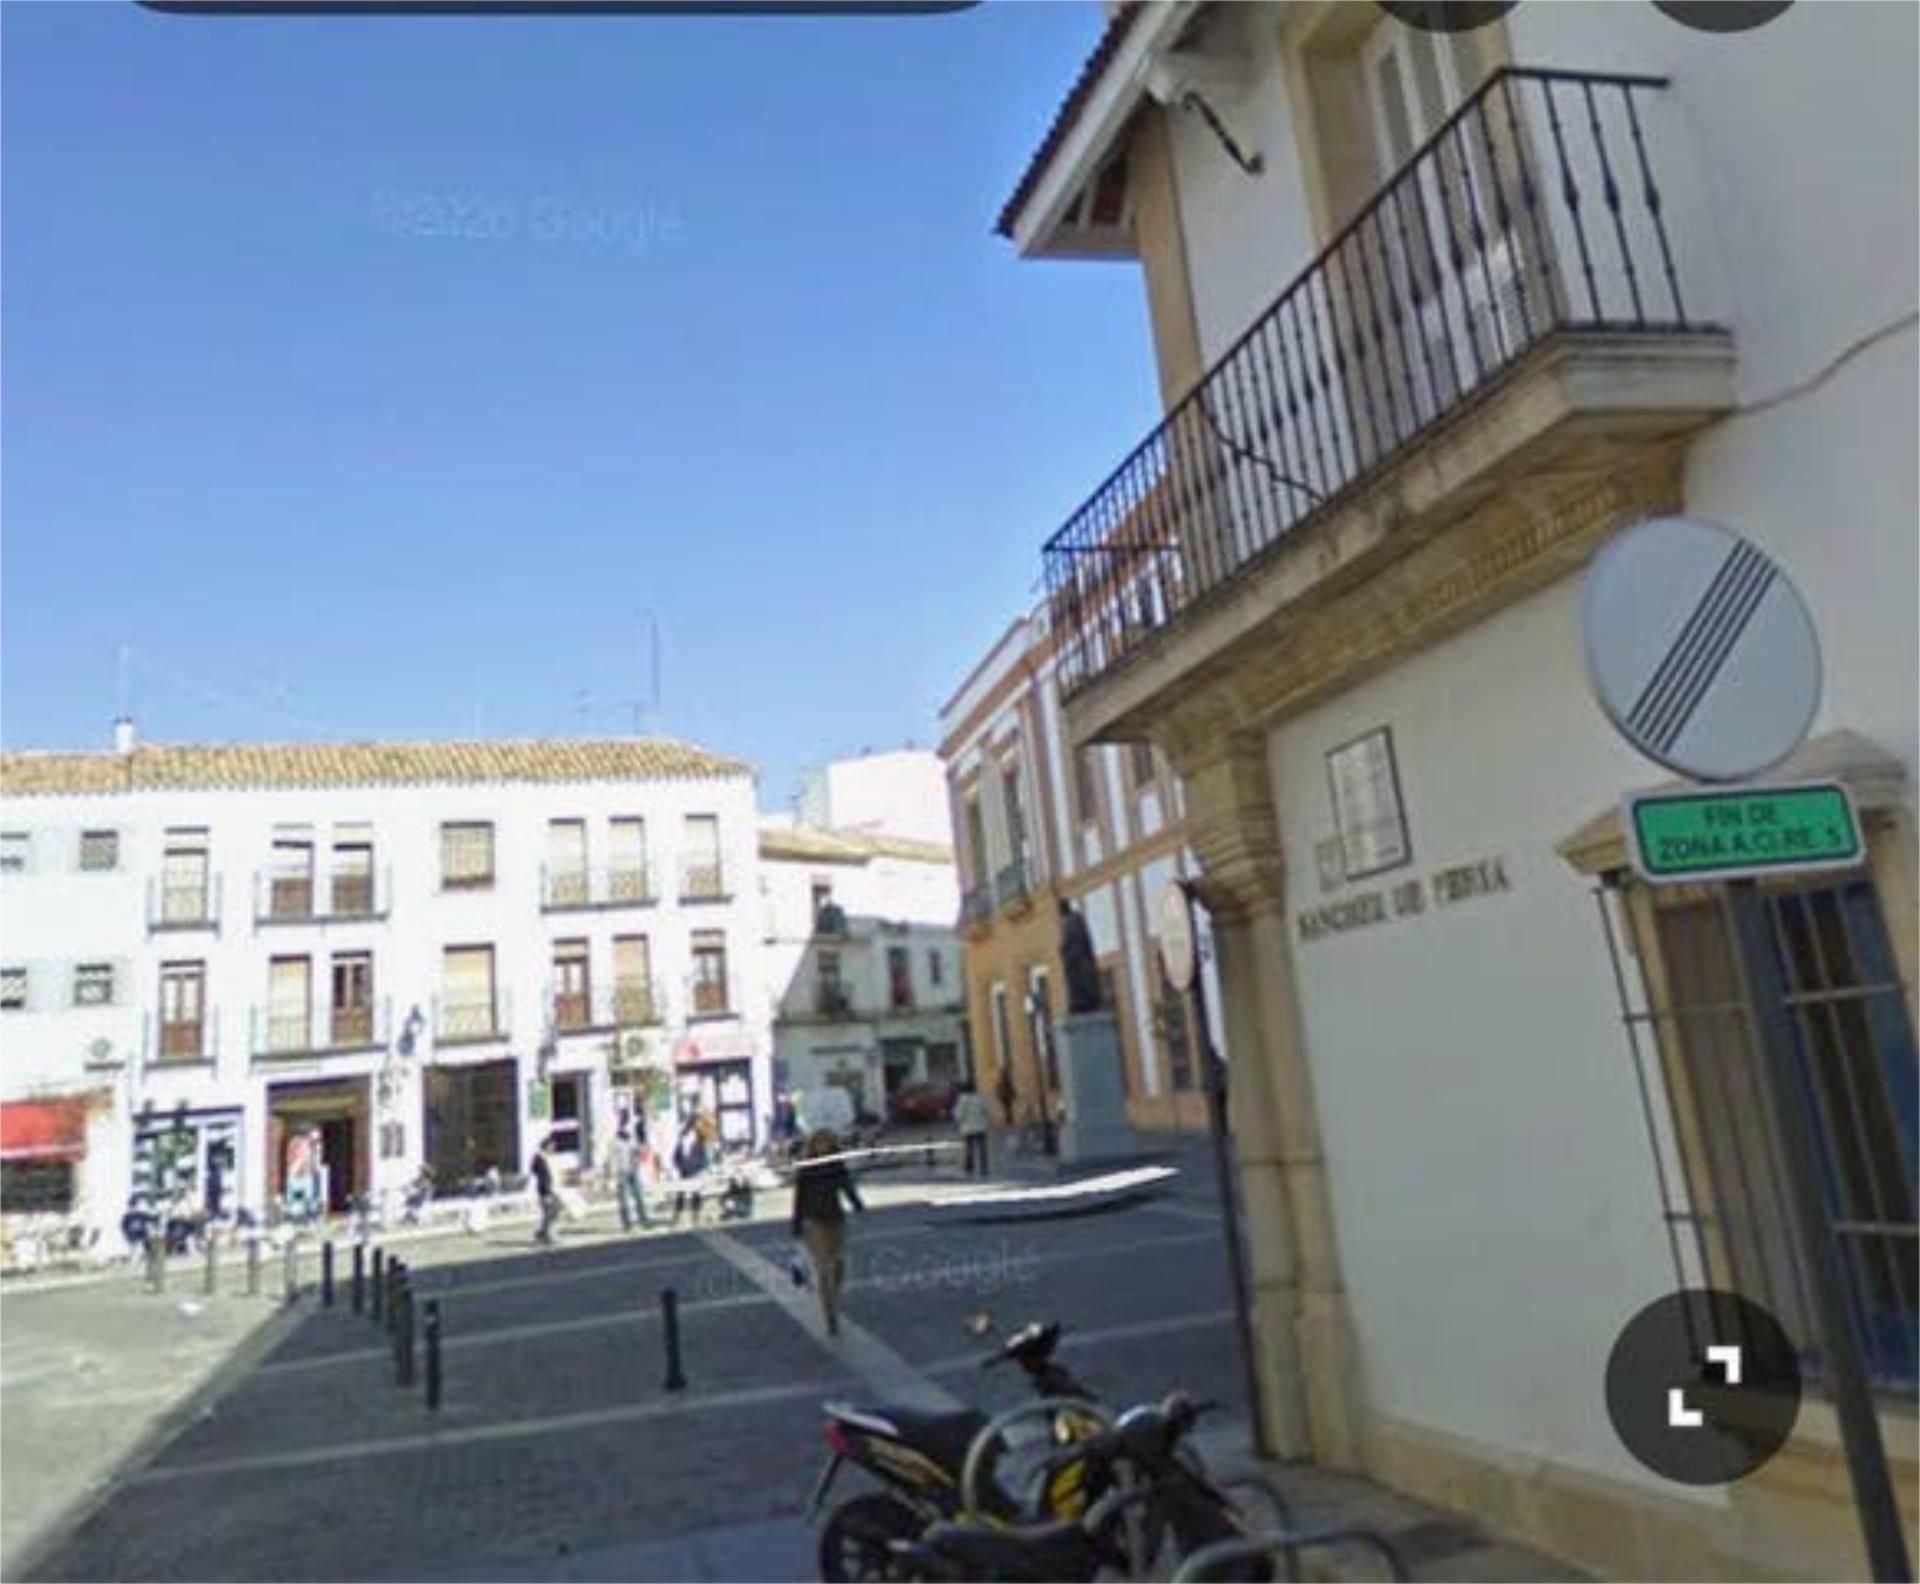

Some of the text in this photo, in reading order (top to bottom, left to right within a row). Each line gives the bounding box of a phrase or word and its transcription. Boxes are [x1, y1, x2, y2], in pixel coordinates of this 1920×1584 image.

[1703, 801, 1778, 828] FIN DE
[1659, 833, 1724, 862] ZONA
